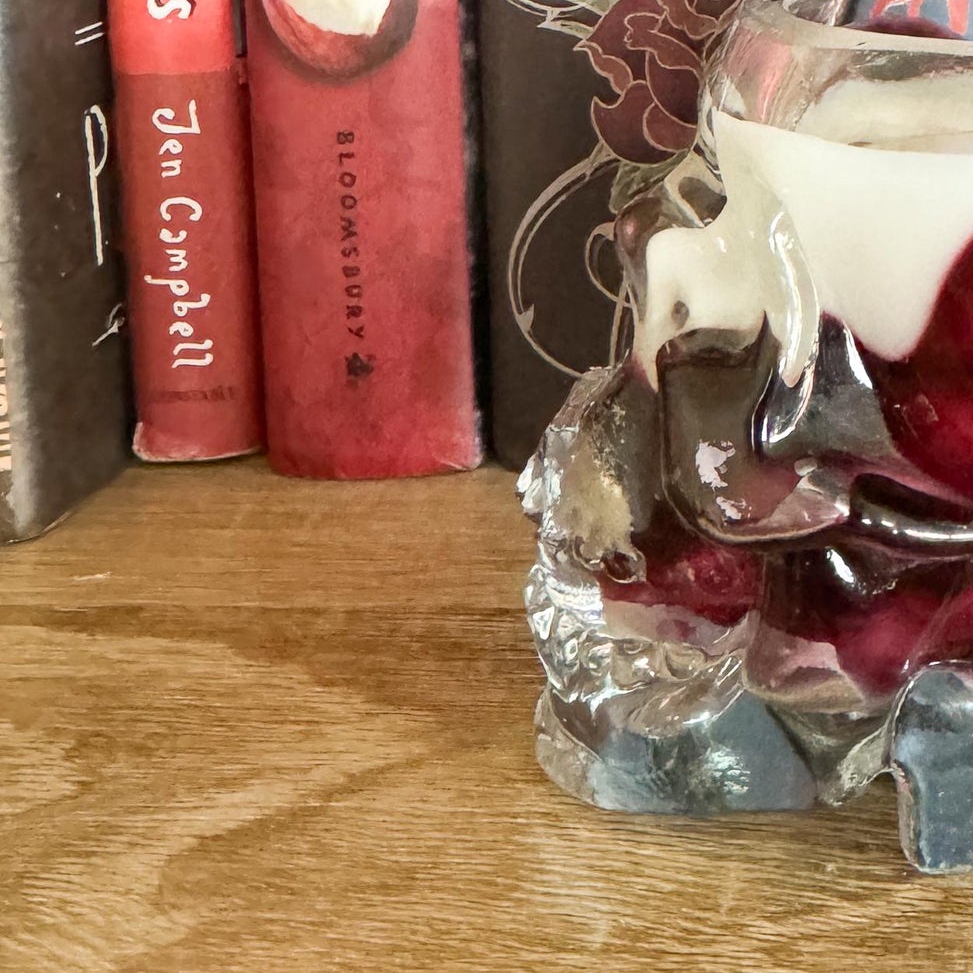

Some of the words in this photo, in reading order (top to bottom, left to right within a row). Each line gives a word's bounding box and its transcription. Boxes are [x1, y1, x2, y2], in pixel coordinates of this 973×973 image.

[152, 99, 201, 179] Jen
[143, 195, 214, 369] Campbell
[336, 130, 366, 340] BLOOMSBURY
